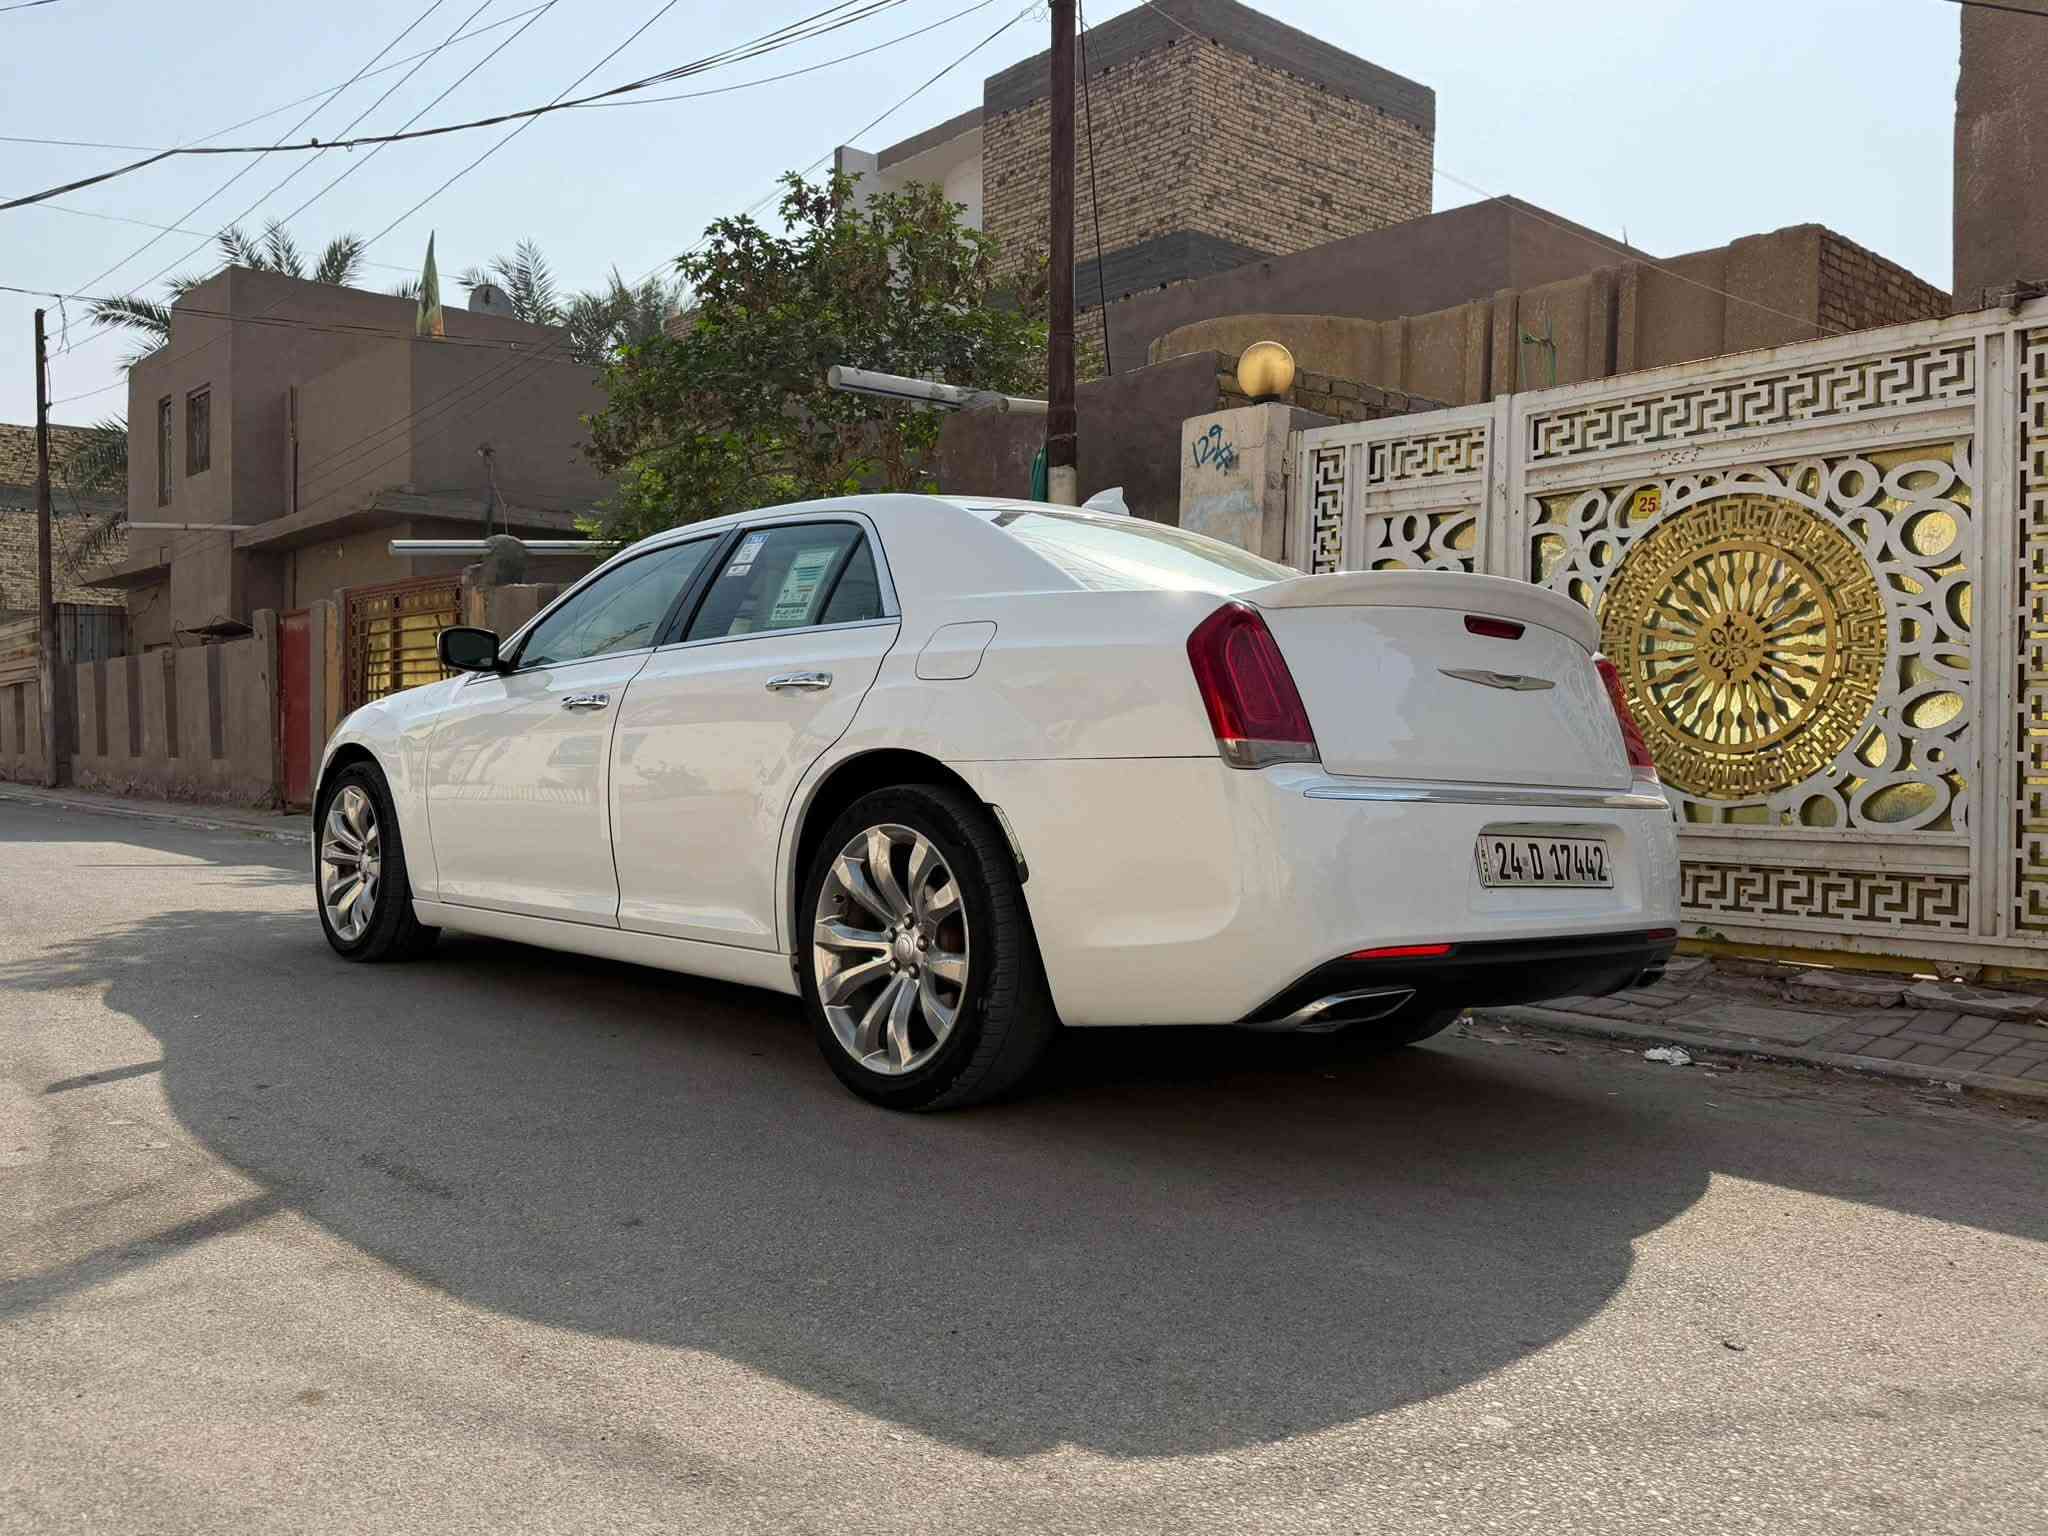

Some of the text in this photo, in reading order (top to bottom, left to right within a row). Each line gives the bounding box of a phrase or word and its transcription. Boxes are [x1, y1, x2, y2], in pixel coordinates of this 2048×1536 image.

[1639, 496, 1657, 513] 25
[1494, 842, 1523, 880] 24
[1527, 843, 1545, 880] D
[1549, 844, 1608, 881] 17442
